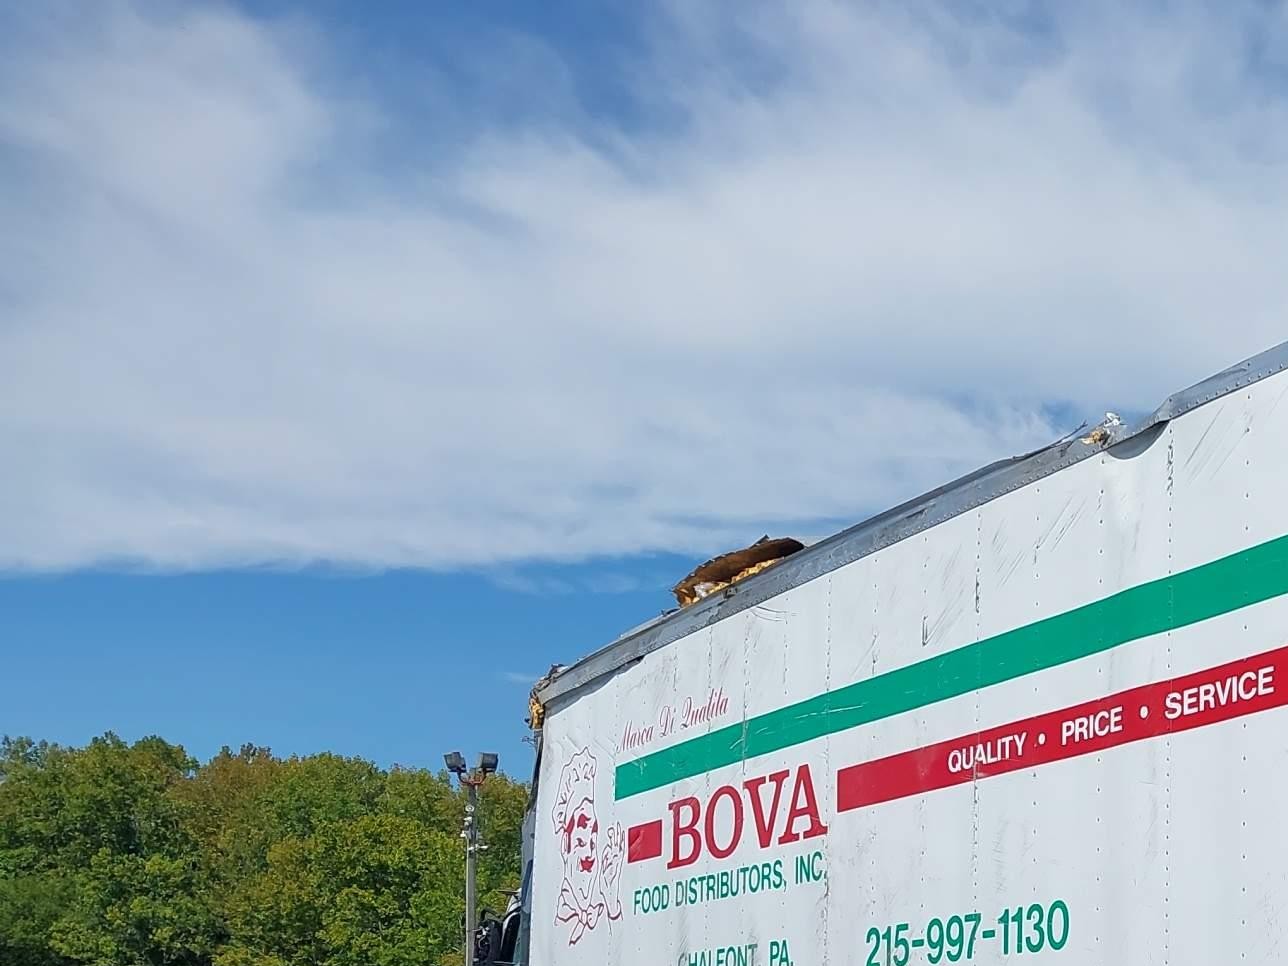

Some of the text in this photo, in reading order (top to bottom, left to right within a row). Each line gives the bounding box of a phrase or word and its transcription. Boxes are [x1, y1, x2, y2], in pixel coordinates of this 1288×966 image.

[948, 666, 1275, 774] QUALITY PRICE SERVICE
[667, 764, 828, 870] BOVA
[633, 884, 670, 916] FOOD
[675, 859, 787, 907] DISTRIBUTORS,
